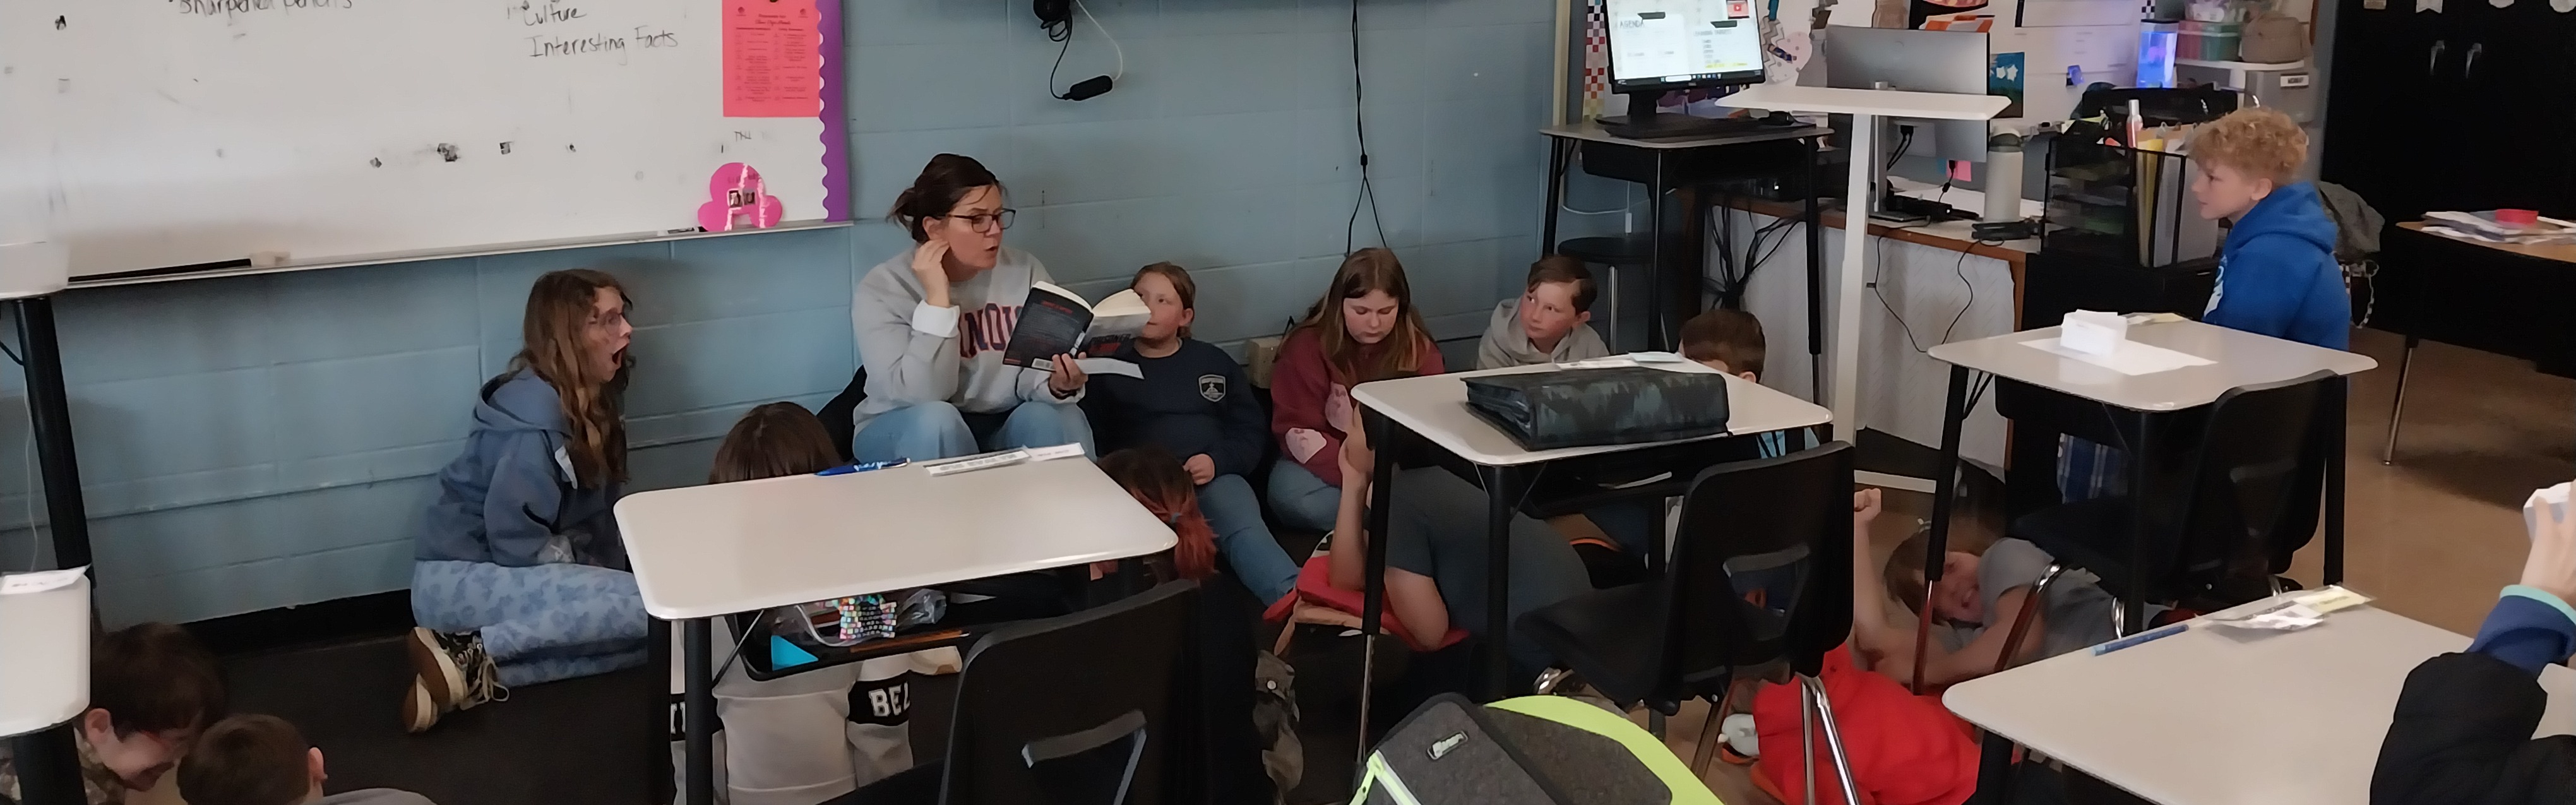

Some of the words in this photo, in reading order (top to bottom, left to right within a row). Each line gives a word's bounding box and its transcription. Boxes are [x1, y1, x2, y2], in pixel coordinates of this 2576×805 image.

[522, 1, 587, 27] Culture
[1619, 20, 1645, 28] AGENDA
[524, 33, 628, 66] Interesting
[634, 25, 679, 48] Facts
